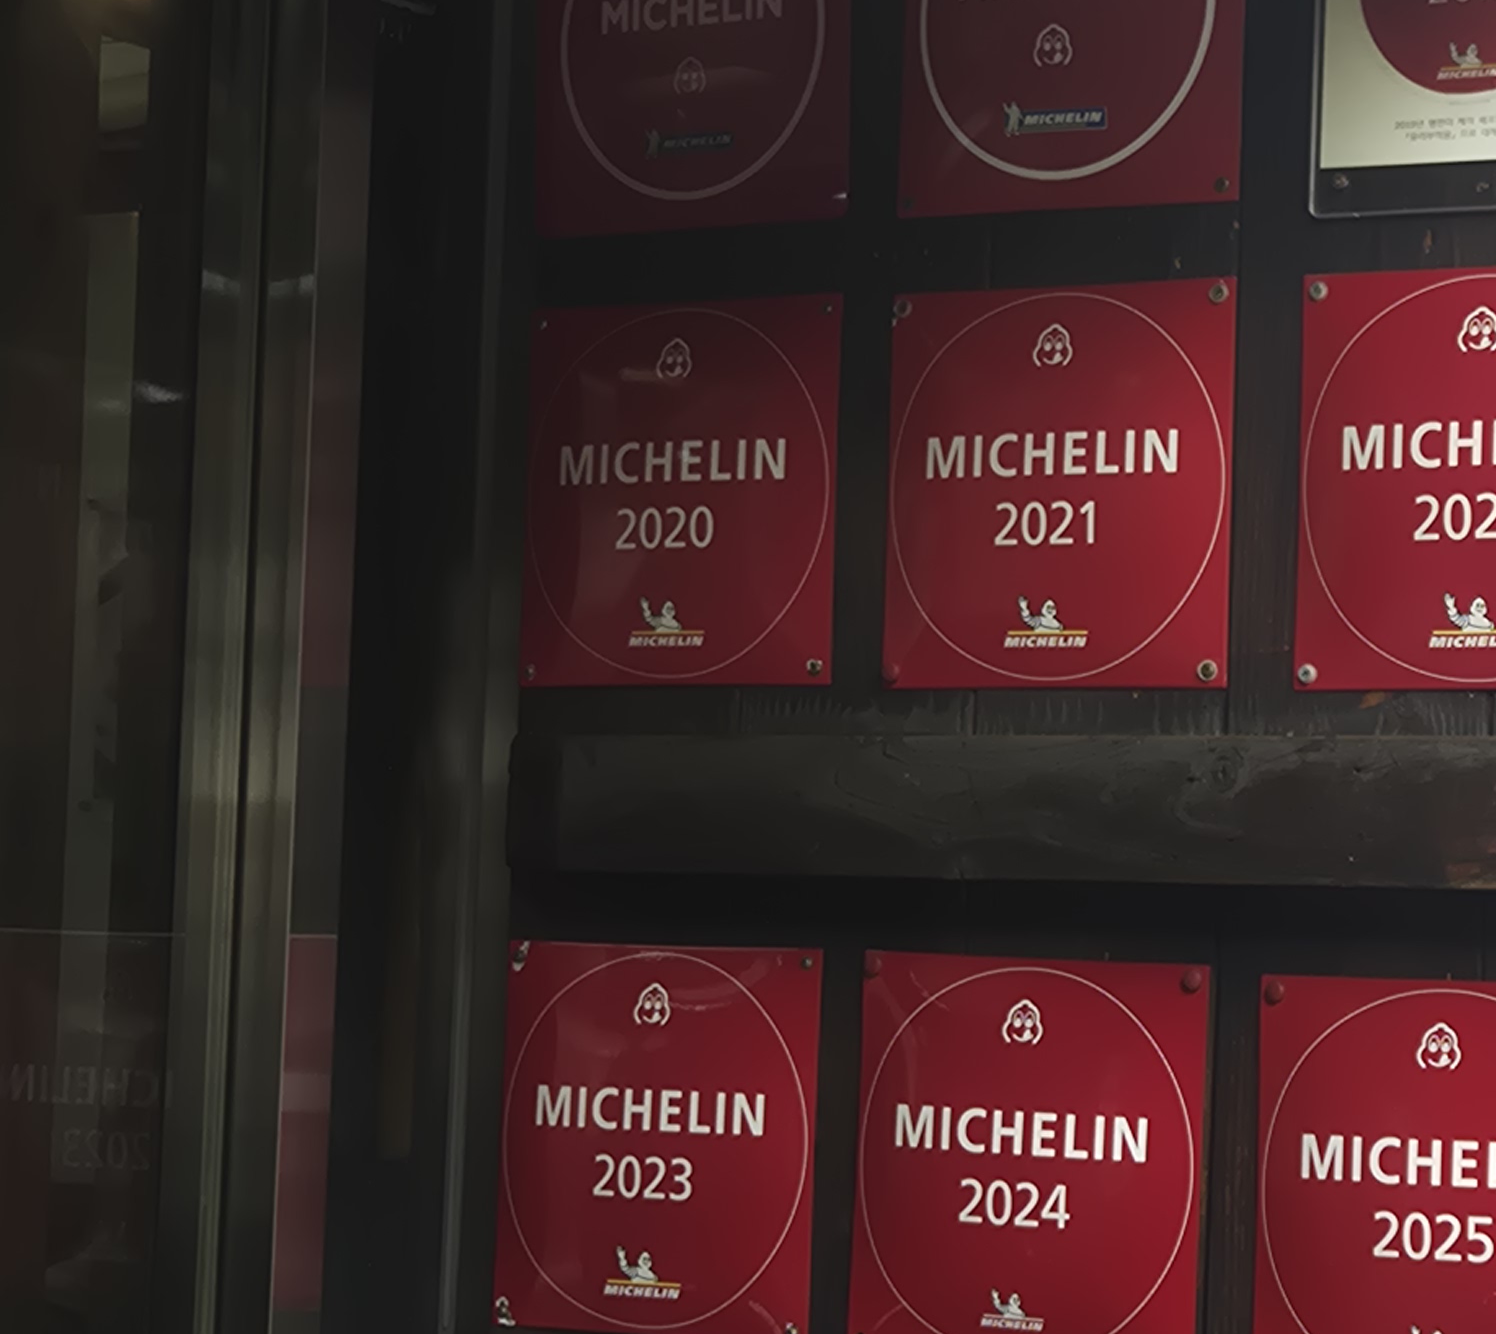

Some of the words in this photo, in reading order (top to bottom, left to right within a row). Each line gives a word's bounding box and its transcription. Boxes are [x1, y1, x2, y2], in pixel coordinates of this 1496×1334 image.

[1023, 109, 1103, 127] MICHELIN
[559, 438, 787, 486] MICHELIN
[926, 428, 1180, 480] MICHELIN
[615, 505, 715, 550] 2020
[994, 500, 1096, 547] 2021
[628, 635, 705, 647] MICHELIN
[1004, 635, 1087, 648] MICHELIN
[534, 1084, 766, 1137] MICHELIN
[894, 1103, 1149, 1163] MICHELIN
[592, 1153, 693, 1202] 2023
[958, 1177, 1071, 1230] 2024
[1372, 1210, 1495, 1264] 2025
[603, 1283, 681, 1300] MICHELIN
[980, 1317, 1044, 1332] MICHELIN
